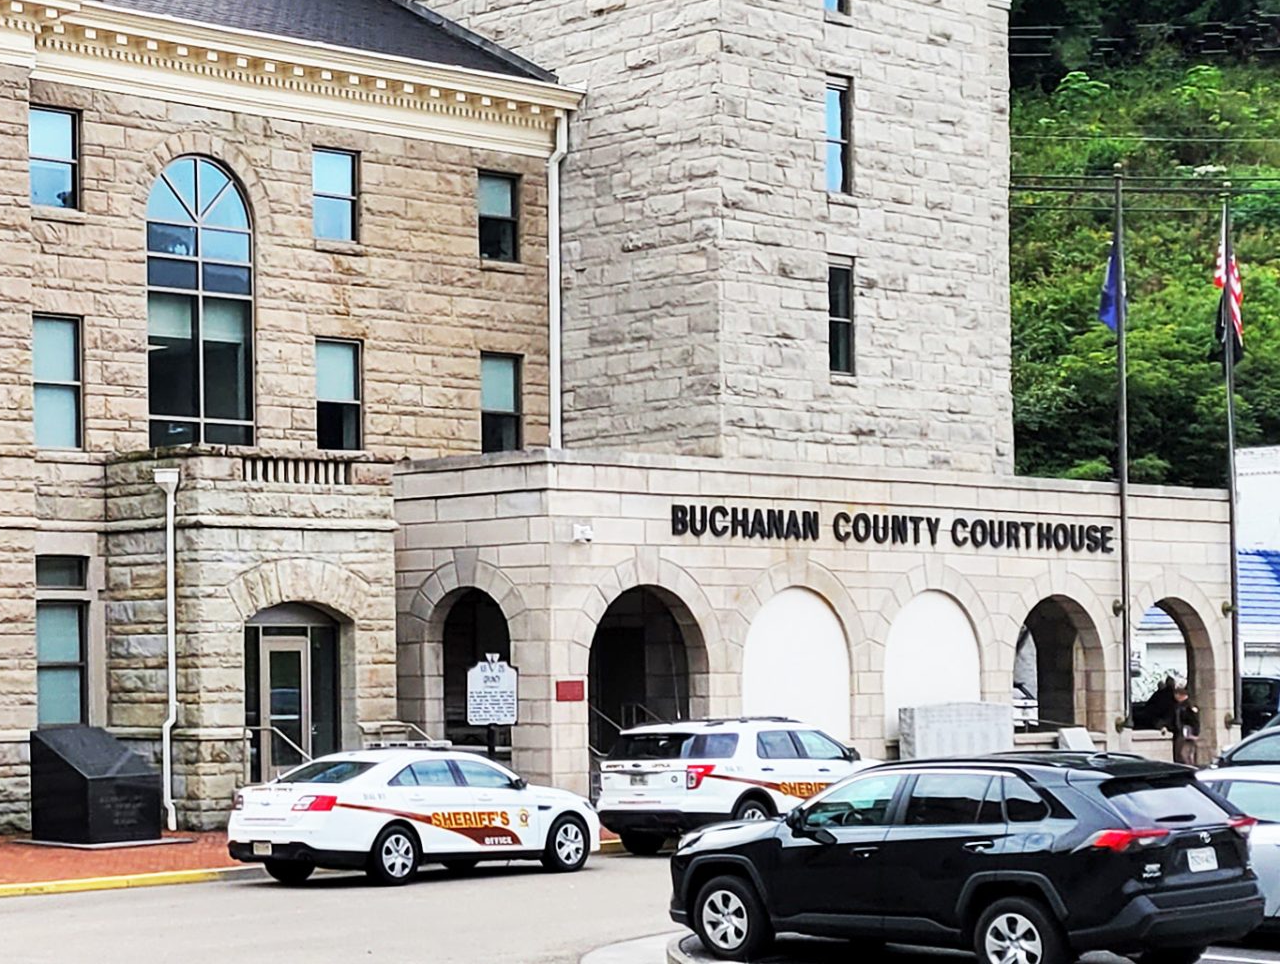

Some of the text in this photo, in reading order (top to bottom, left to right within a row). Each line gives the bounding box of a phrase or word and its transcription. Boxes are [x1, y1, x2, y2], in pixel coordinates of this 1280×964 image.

[671, 503, 1115, 554] BUCHANAN COUNTY COURTHOUSE
[431, 810, 510, 828] SHERIFF'S
[484, 836, 514, 845] OFFICE
